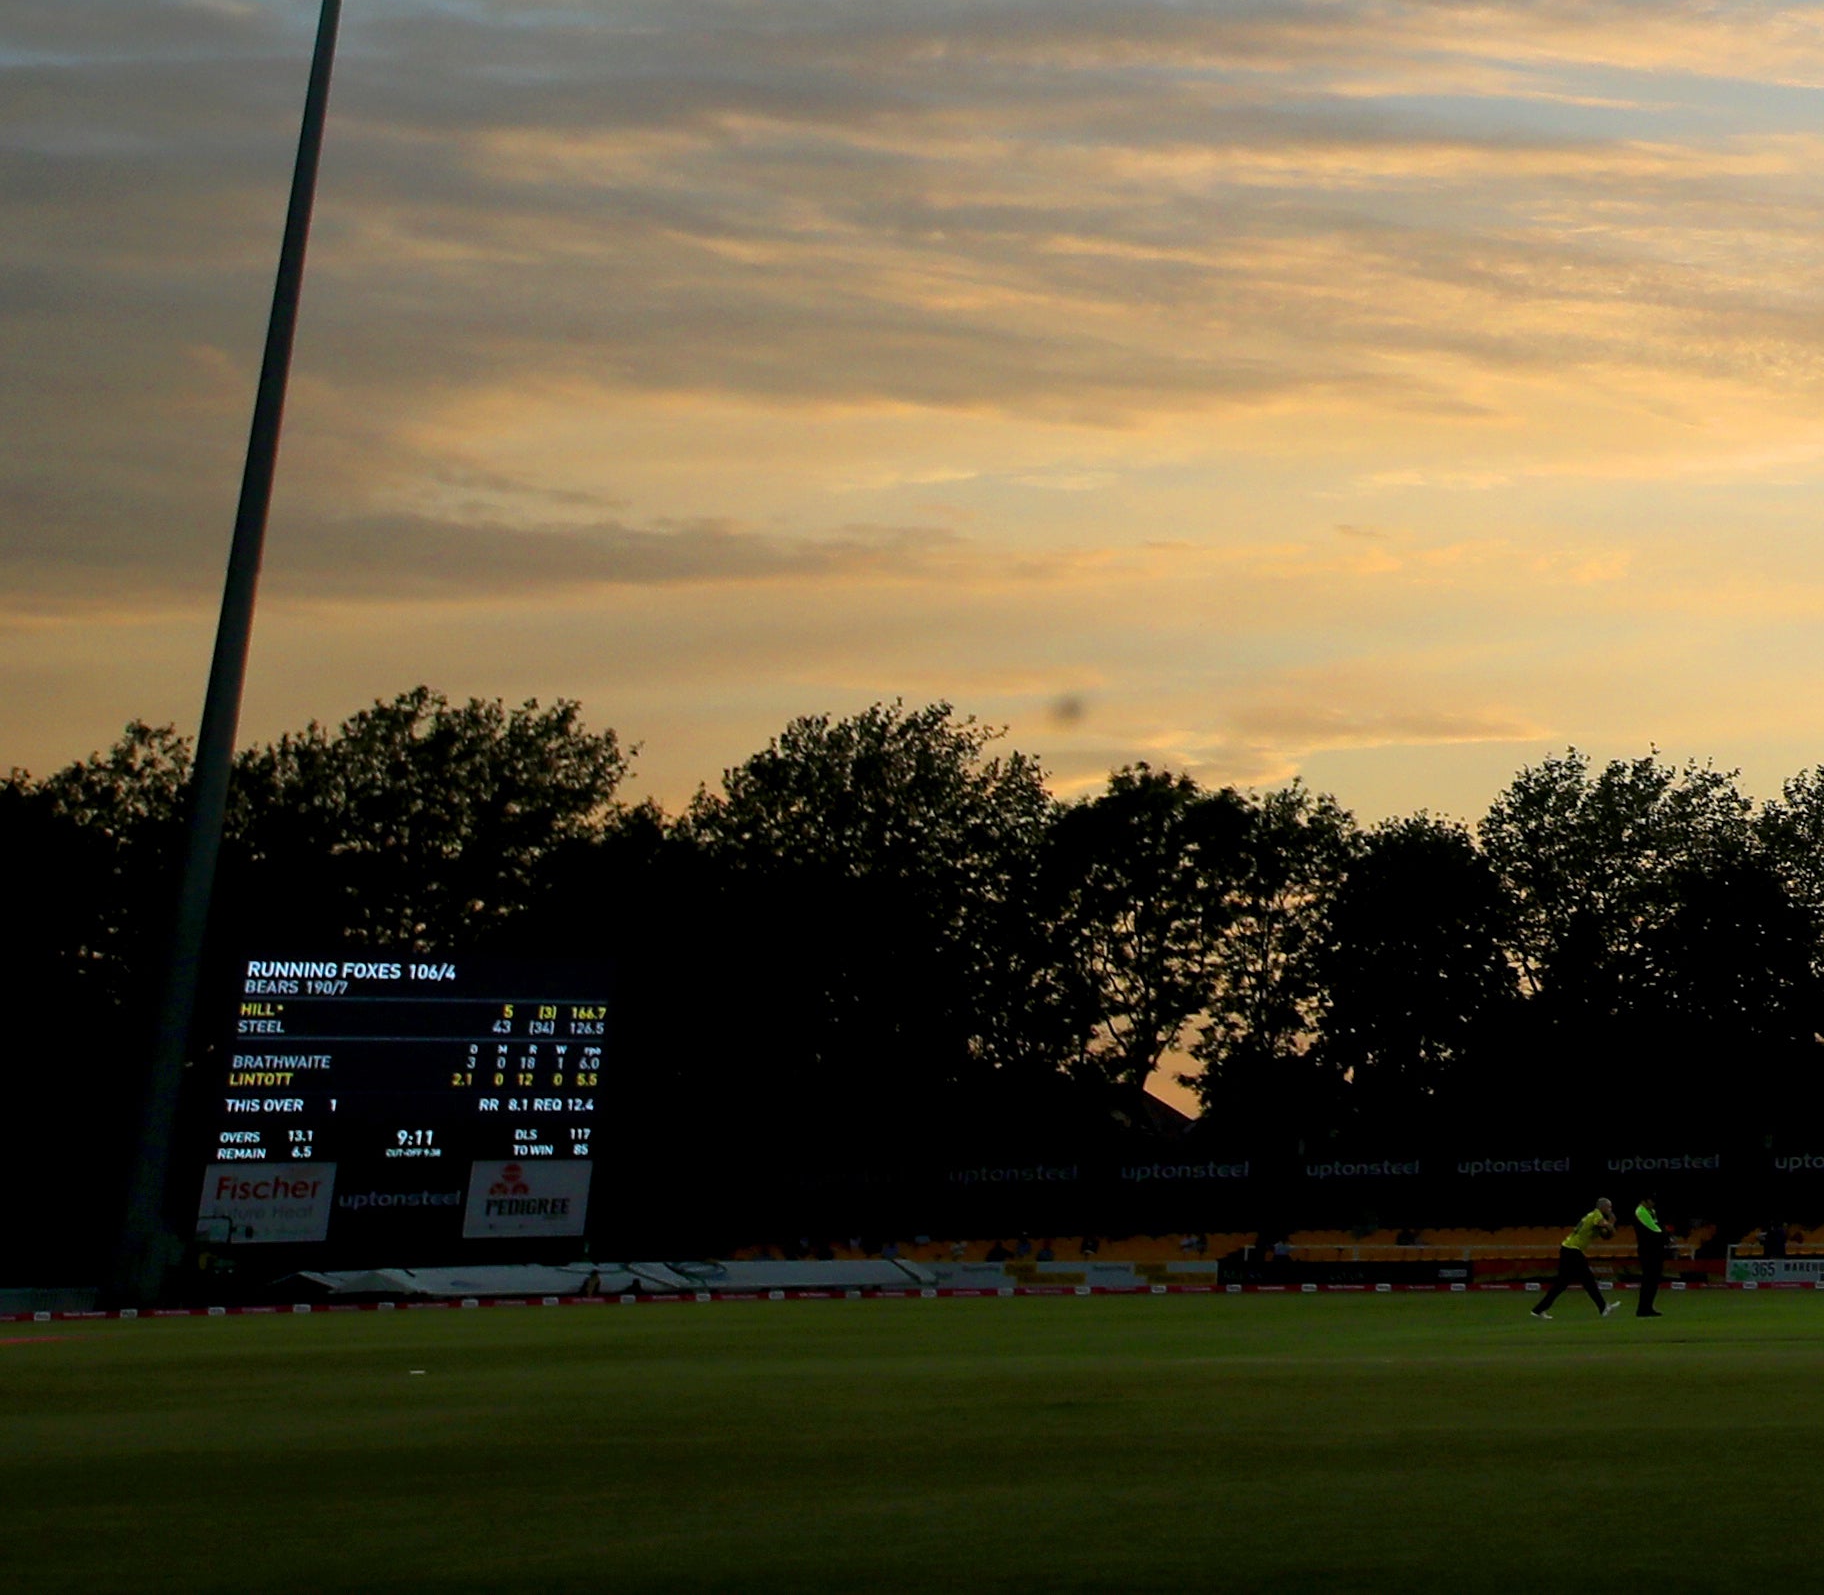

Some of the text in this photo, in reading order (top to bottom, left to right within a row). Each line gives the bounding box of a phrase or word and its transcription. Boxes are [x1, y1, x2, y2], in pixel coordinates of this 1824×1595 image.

[247, 961, 456, 981] RUNNING FOXES 106/4
[244, 979, 348, 995] BEARS 190/7
[503, 1004, 514, 1018] 5
[538, 1005, 557, 1020] (3)
[571, 1007, 606, 1020] 166.7
[238, 1019, 604, 1035] STEEL 43 (34) 126.5
[556, 1044, 567, 1054] W
[233, 1055, 600, 1069] BRATHWAITE 3 0 18 1 6.0
[229, 1073, 597, 1086] LINTOTT 2.1 0 12 0 5.5
[225, 1098, 594, 1112] THIS OVER 1 RR 8.1 REQ 12.4
[219, 1128, 591, 1146] OVERS 13.1 9:11 DLS 117
[217, 1148, 266, 1160] REMAIN
[292, 1146, 312, 1159] 6.5
[513, 1145, 528, 1156] TO
[530, 1145, 554, 1156] WIN
[573, 1144, 589, 1155] 85
[1121, 1160, 1249, 1182] uptonsteel
[1306, 1159, 1420, 1179] uptonsteel
[1457, 1157, 1570, 1176] uptonsteel
[1607, 1154, 1720, 1173] uptonsteel
[216, 1174, 324, 1200] Fischer
[339, 1189, 462, 1210] uptonsteel
[485, 1197, 571, 1216] PEDIGREE
[1752, 1261, 1775, 1277] 365
